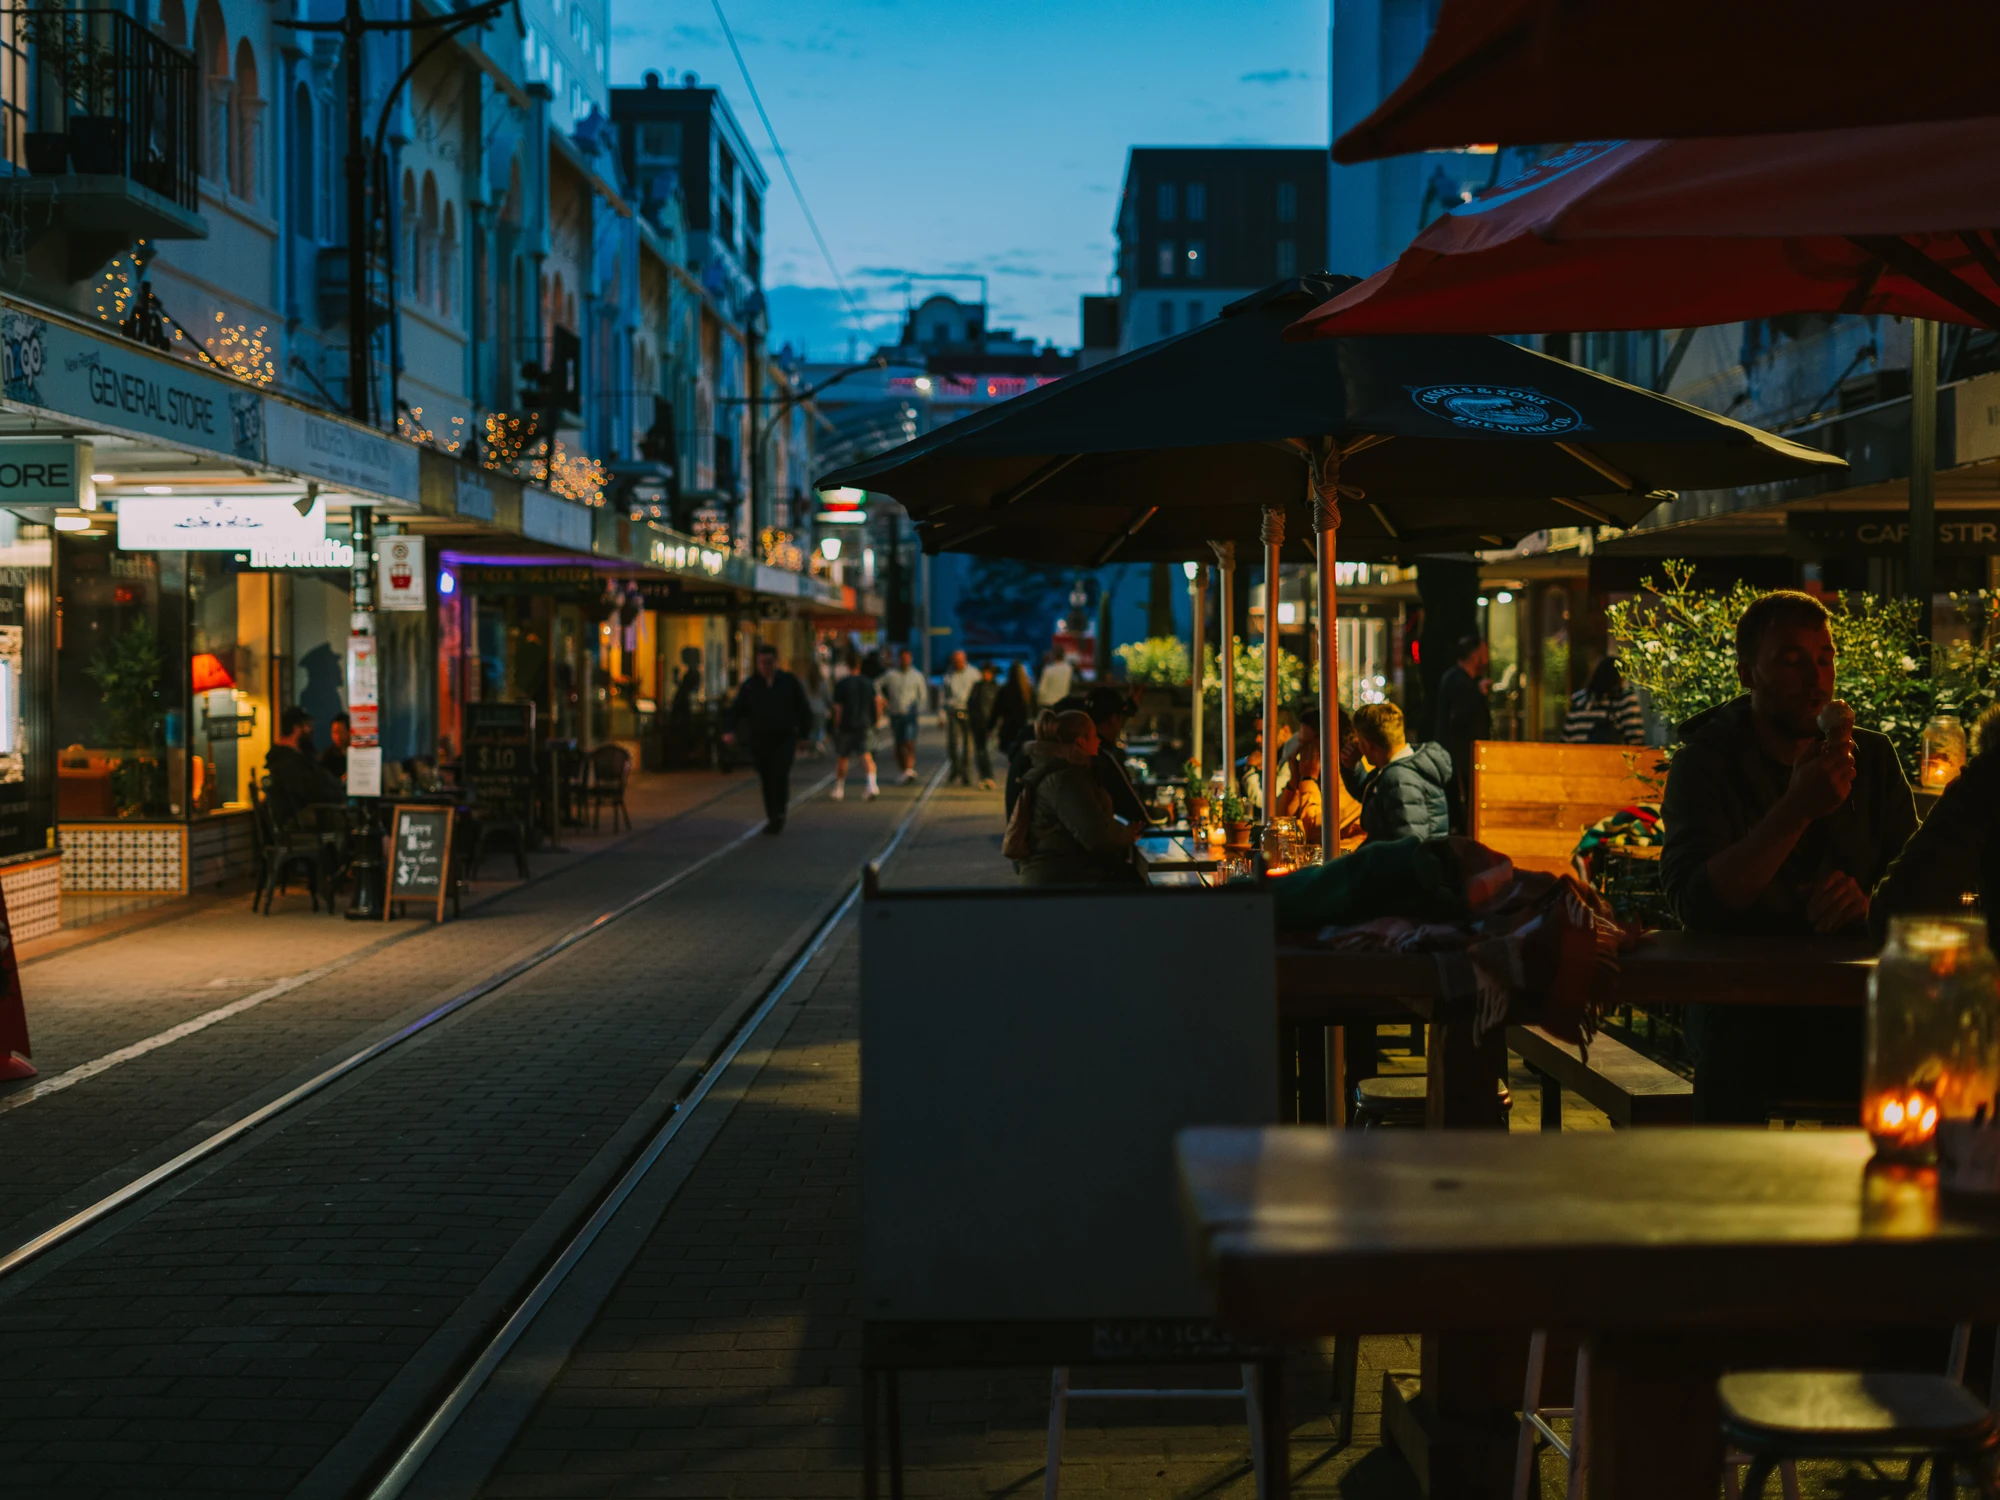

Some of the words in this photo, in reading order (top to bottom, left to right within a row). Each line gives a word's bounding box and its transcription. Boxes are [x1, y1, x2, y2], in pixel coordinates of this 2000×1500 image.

[89, 364, 166, 421] GENERAL
[168, 388, 214, 435] STORE
[1421, 386, 1472, 405] CASSELS
[1496, 388, 1551, 406] SONS
[1452, 415, 1559, 433] BREWING
[1856, 523, 1911, 545] CAF
[1939, 522, 1997, 544] STIR
